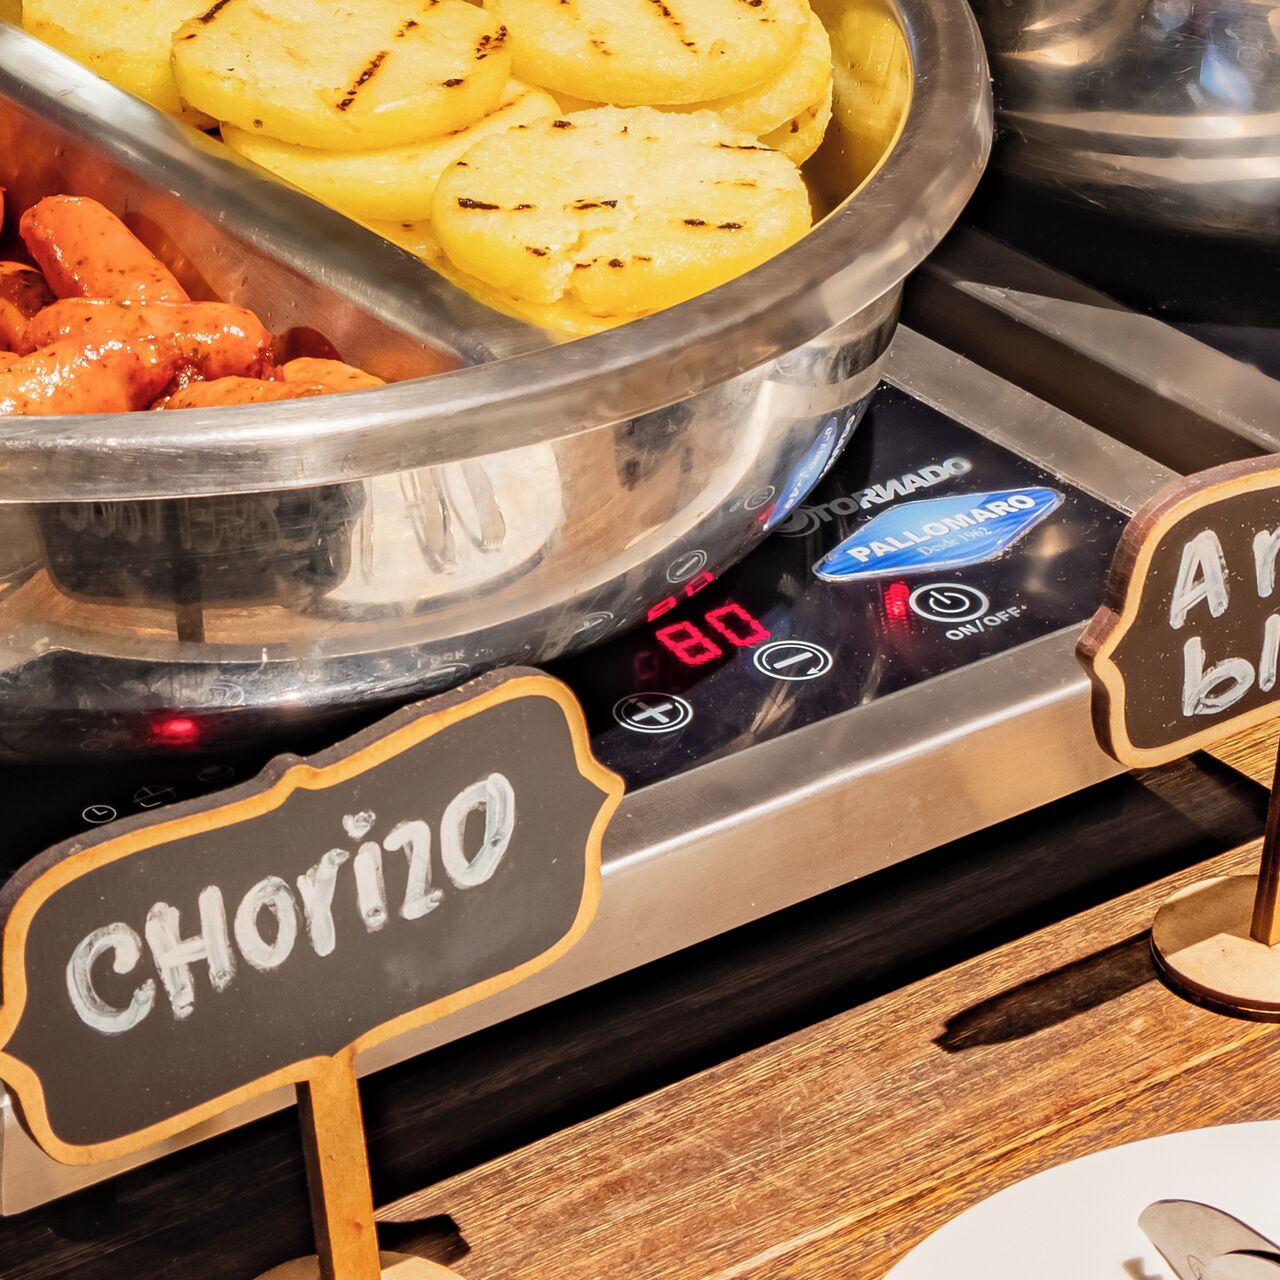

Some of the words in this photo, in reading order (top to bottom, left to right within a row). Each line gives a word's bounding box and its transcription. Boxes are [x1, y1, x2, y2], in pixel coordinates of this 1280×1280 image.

[816, 457, 972, 523] TORNADO
[846, 494, 1036, 563] PALLOMARO
[656, 603, 771, 664] 80
[945, 606, 1021, 640] ON/OFF
